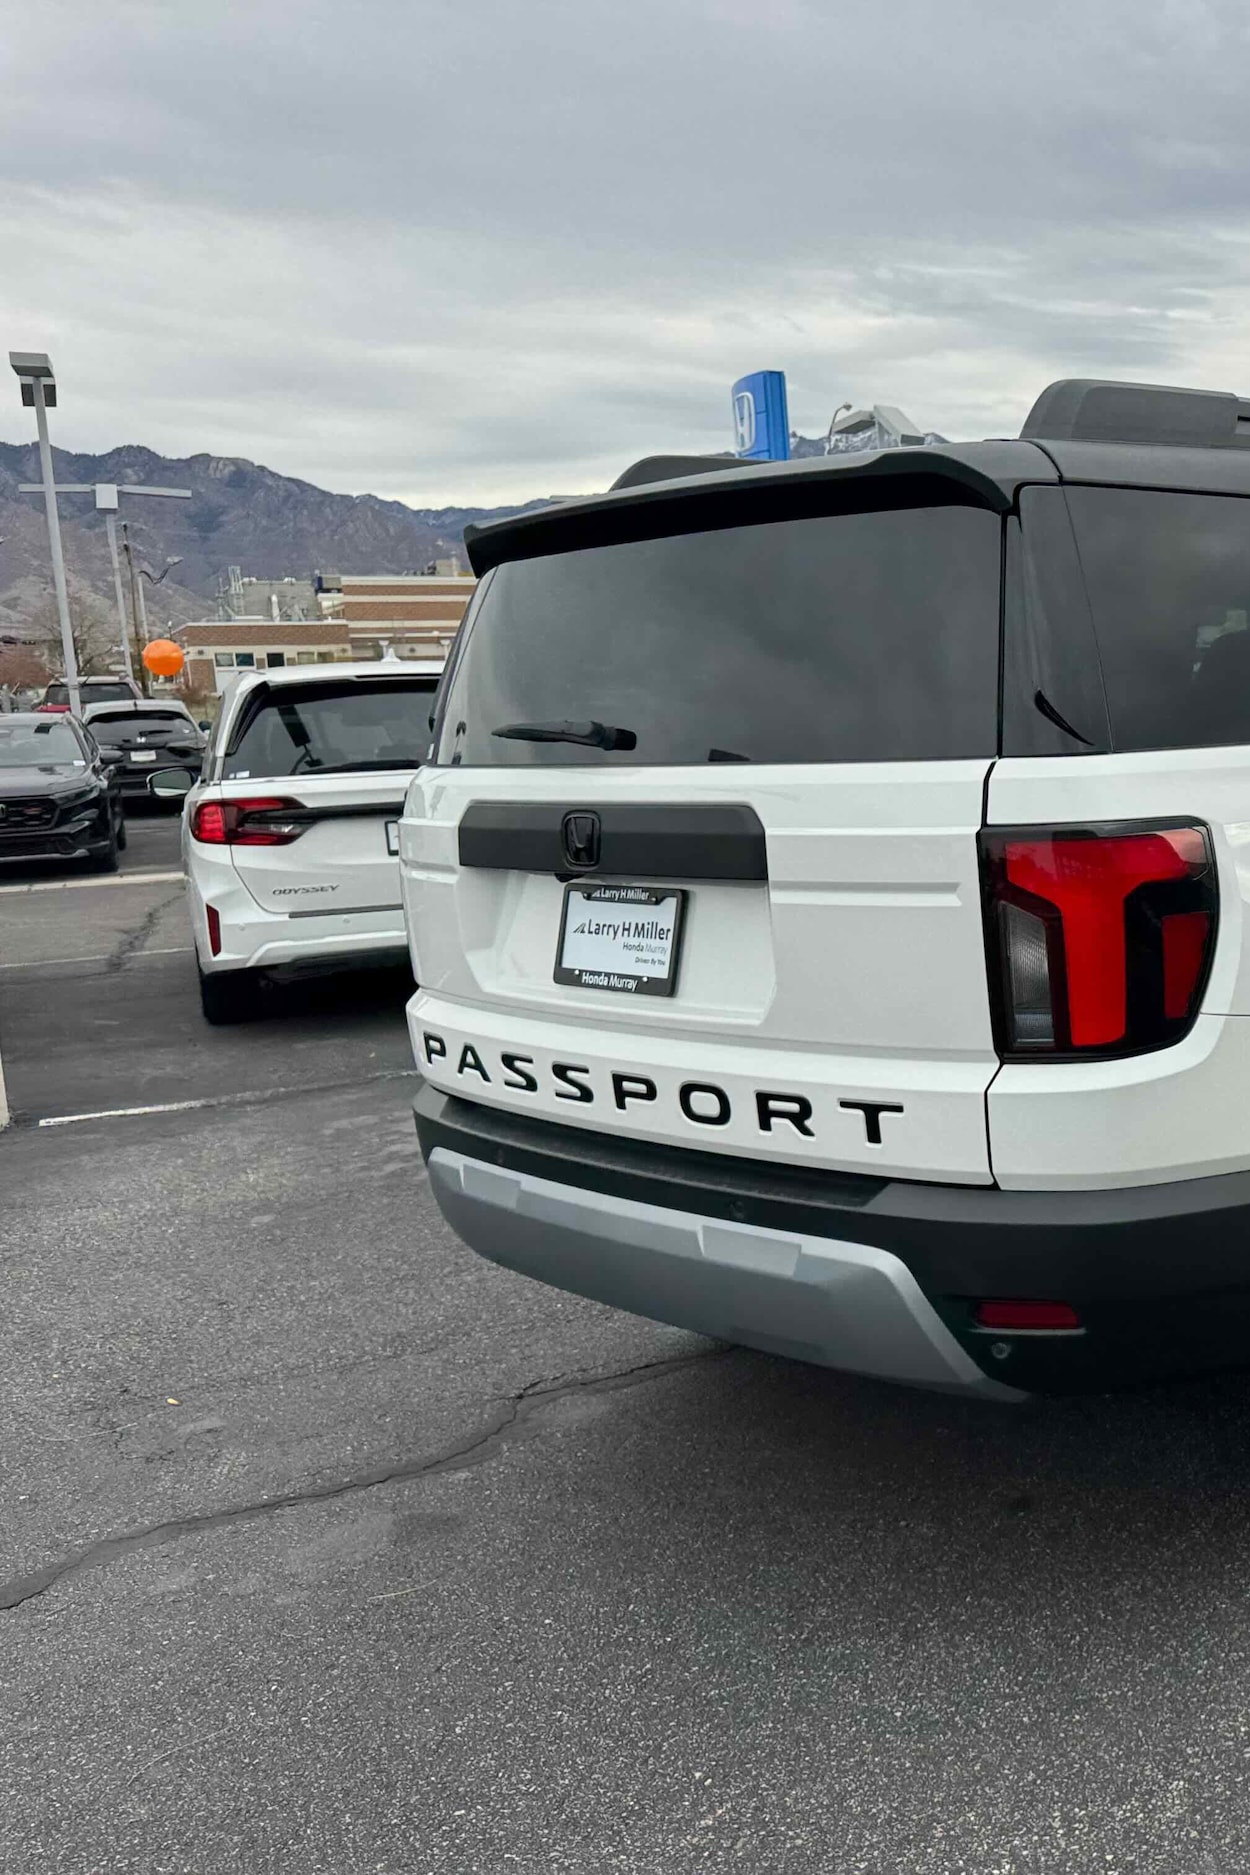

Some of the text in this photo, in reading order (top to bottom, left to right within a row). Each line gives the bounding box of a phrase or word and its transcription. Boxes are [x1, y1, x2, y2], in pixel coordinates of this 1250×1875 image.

[272, 884, 340, 896] ODYSSEY
[601, 888, 650, 901] Larry H Miller
[588, 919, 671, 941] Larry H Miller
[622, 942, 668, 955] Honda Murray
[651, 958, 657, 966] By
[581, 972, 638, 991] Honda Murray
[422, 1031, 905, 1145] PASSPORT
